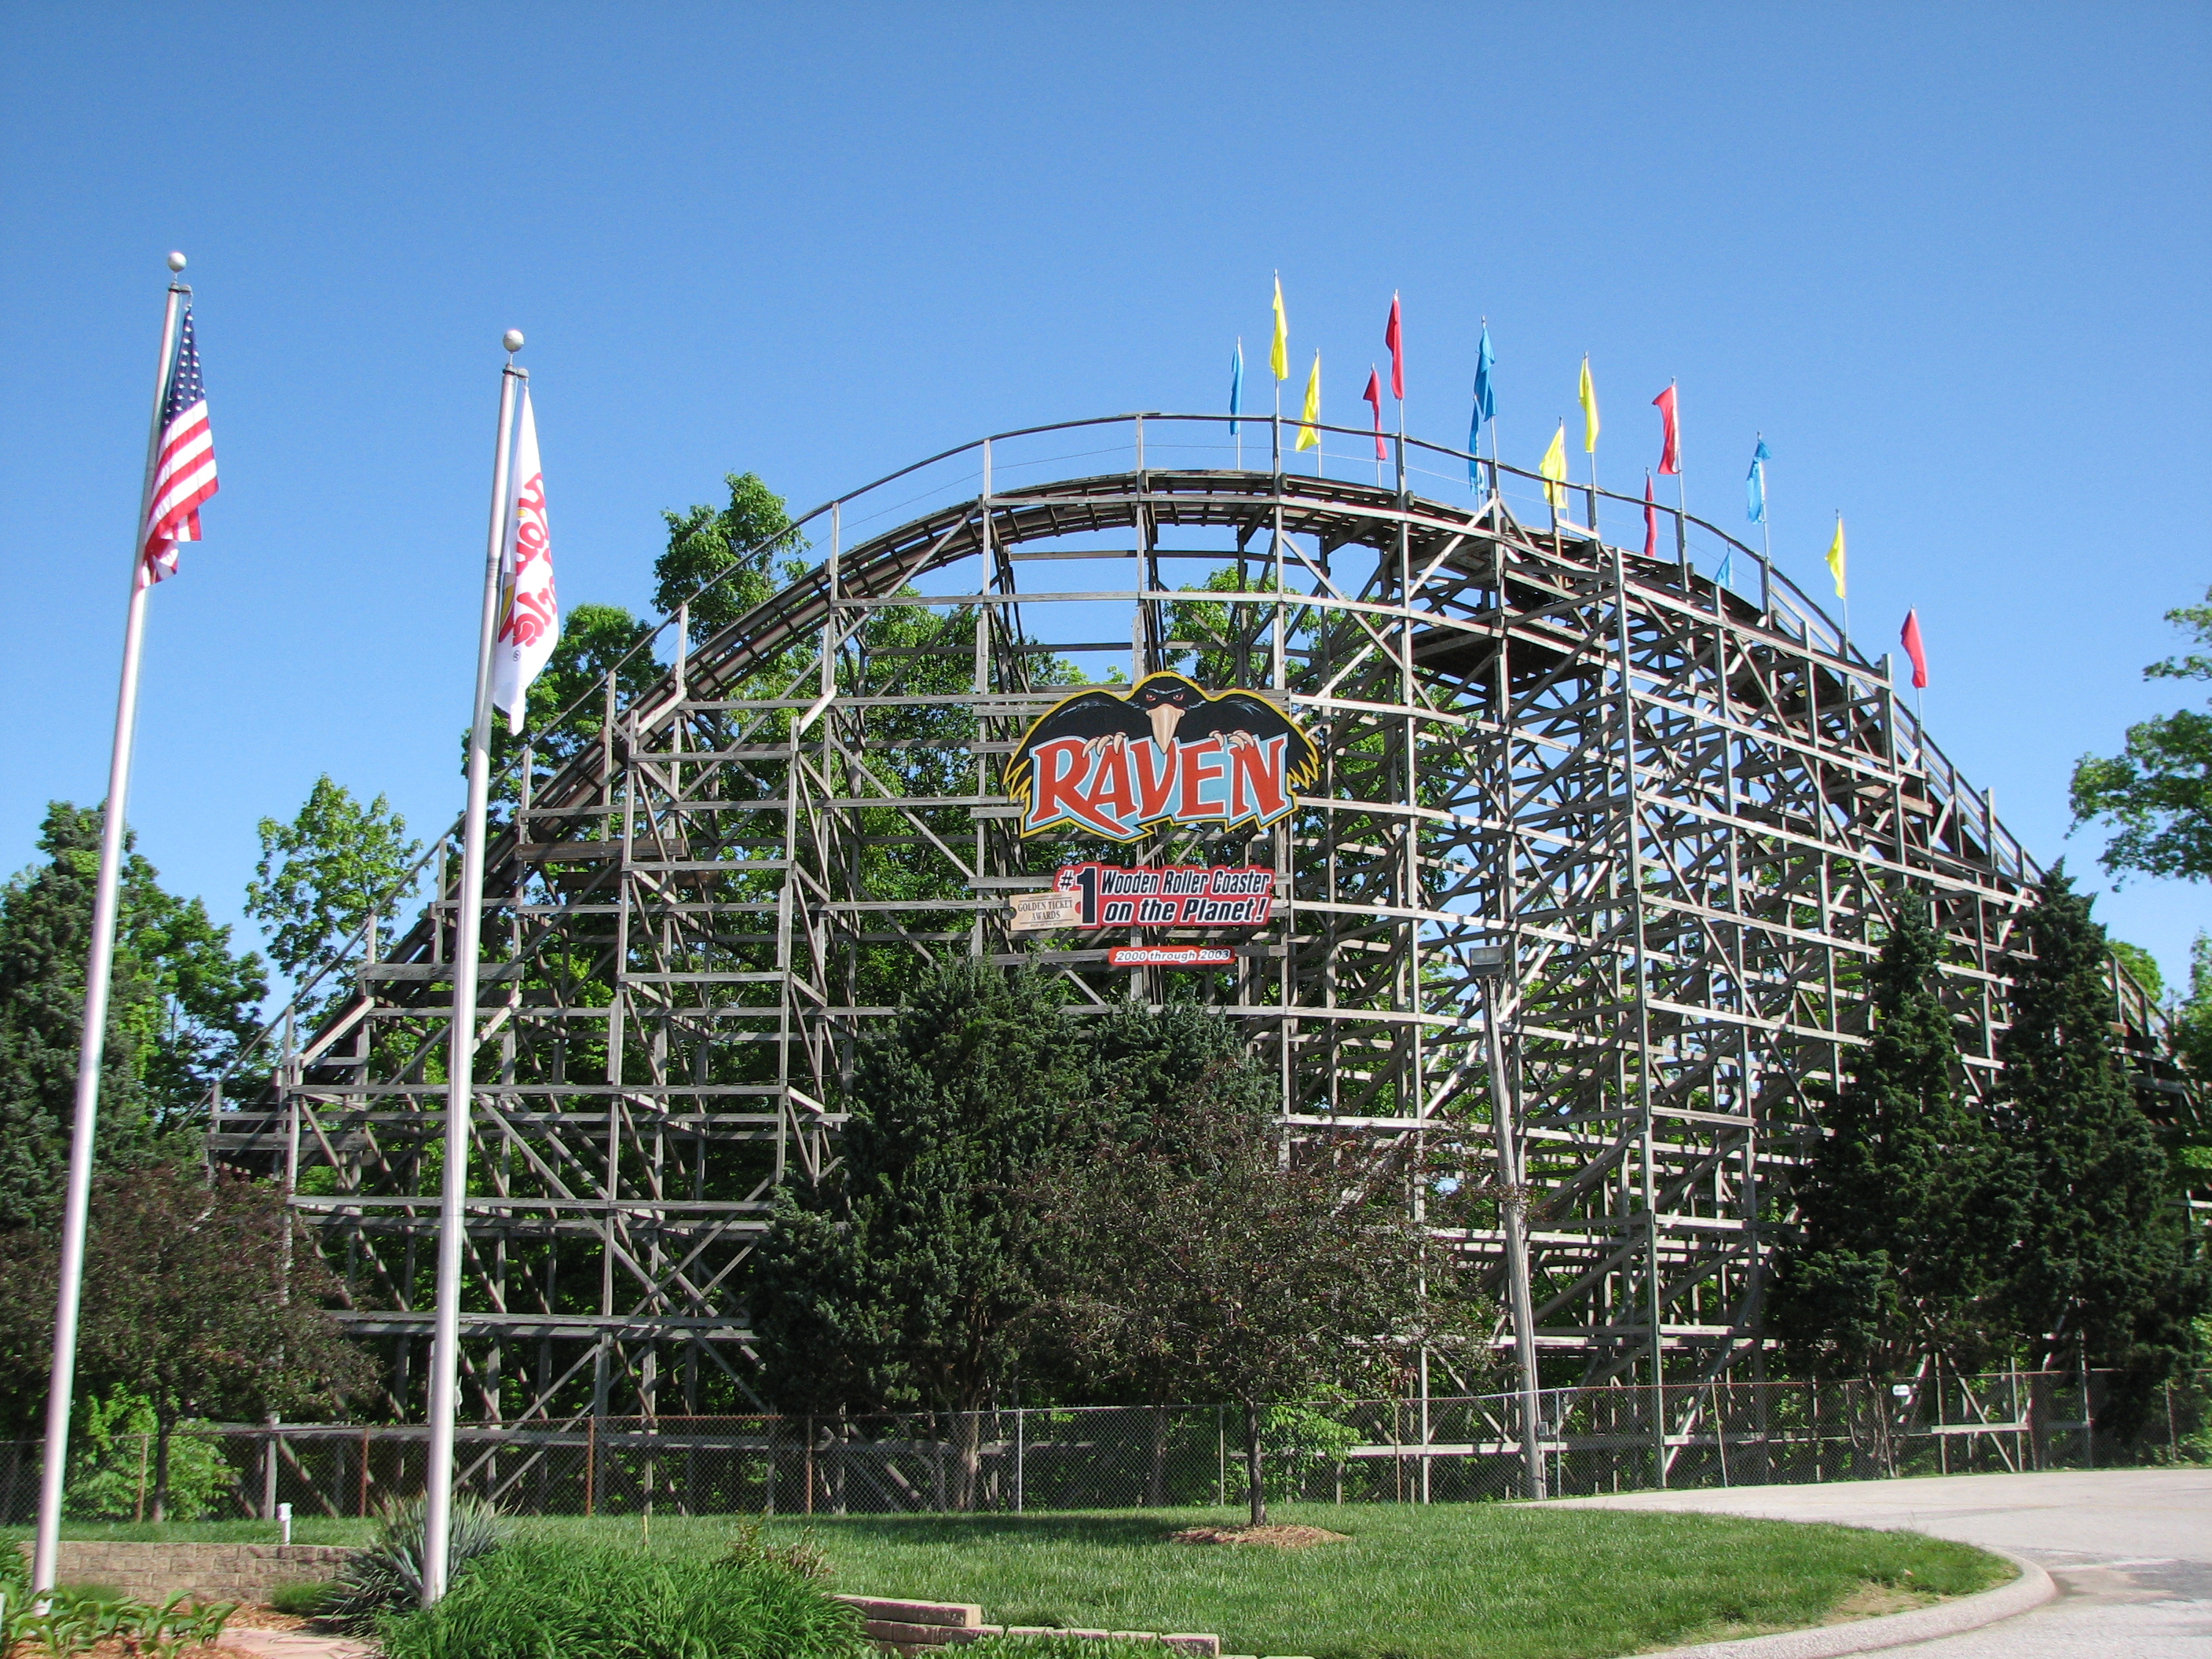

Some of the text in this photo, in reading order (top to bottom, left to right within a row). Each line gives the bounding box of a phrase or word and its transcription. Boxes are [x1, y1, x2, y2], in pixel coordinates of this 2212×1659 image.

[1031, 738, 1287, 835] RAVEN
[1059, 867, 1271, 924] #1 Wooden Roller Coaster
[1017, 899, 1073, 912] GOLDEN TICKET
[1104, 898, 1267, 922] on the Planet!
[1031, 910, 1060, 921] AWARDS
[1116, 950, 1230, 961] 2000 through 2003
